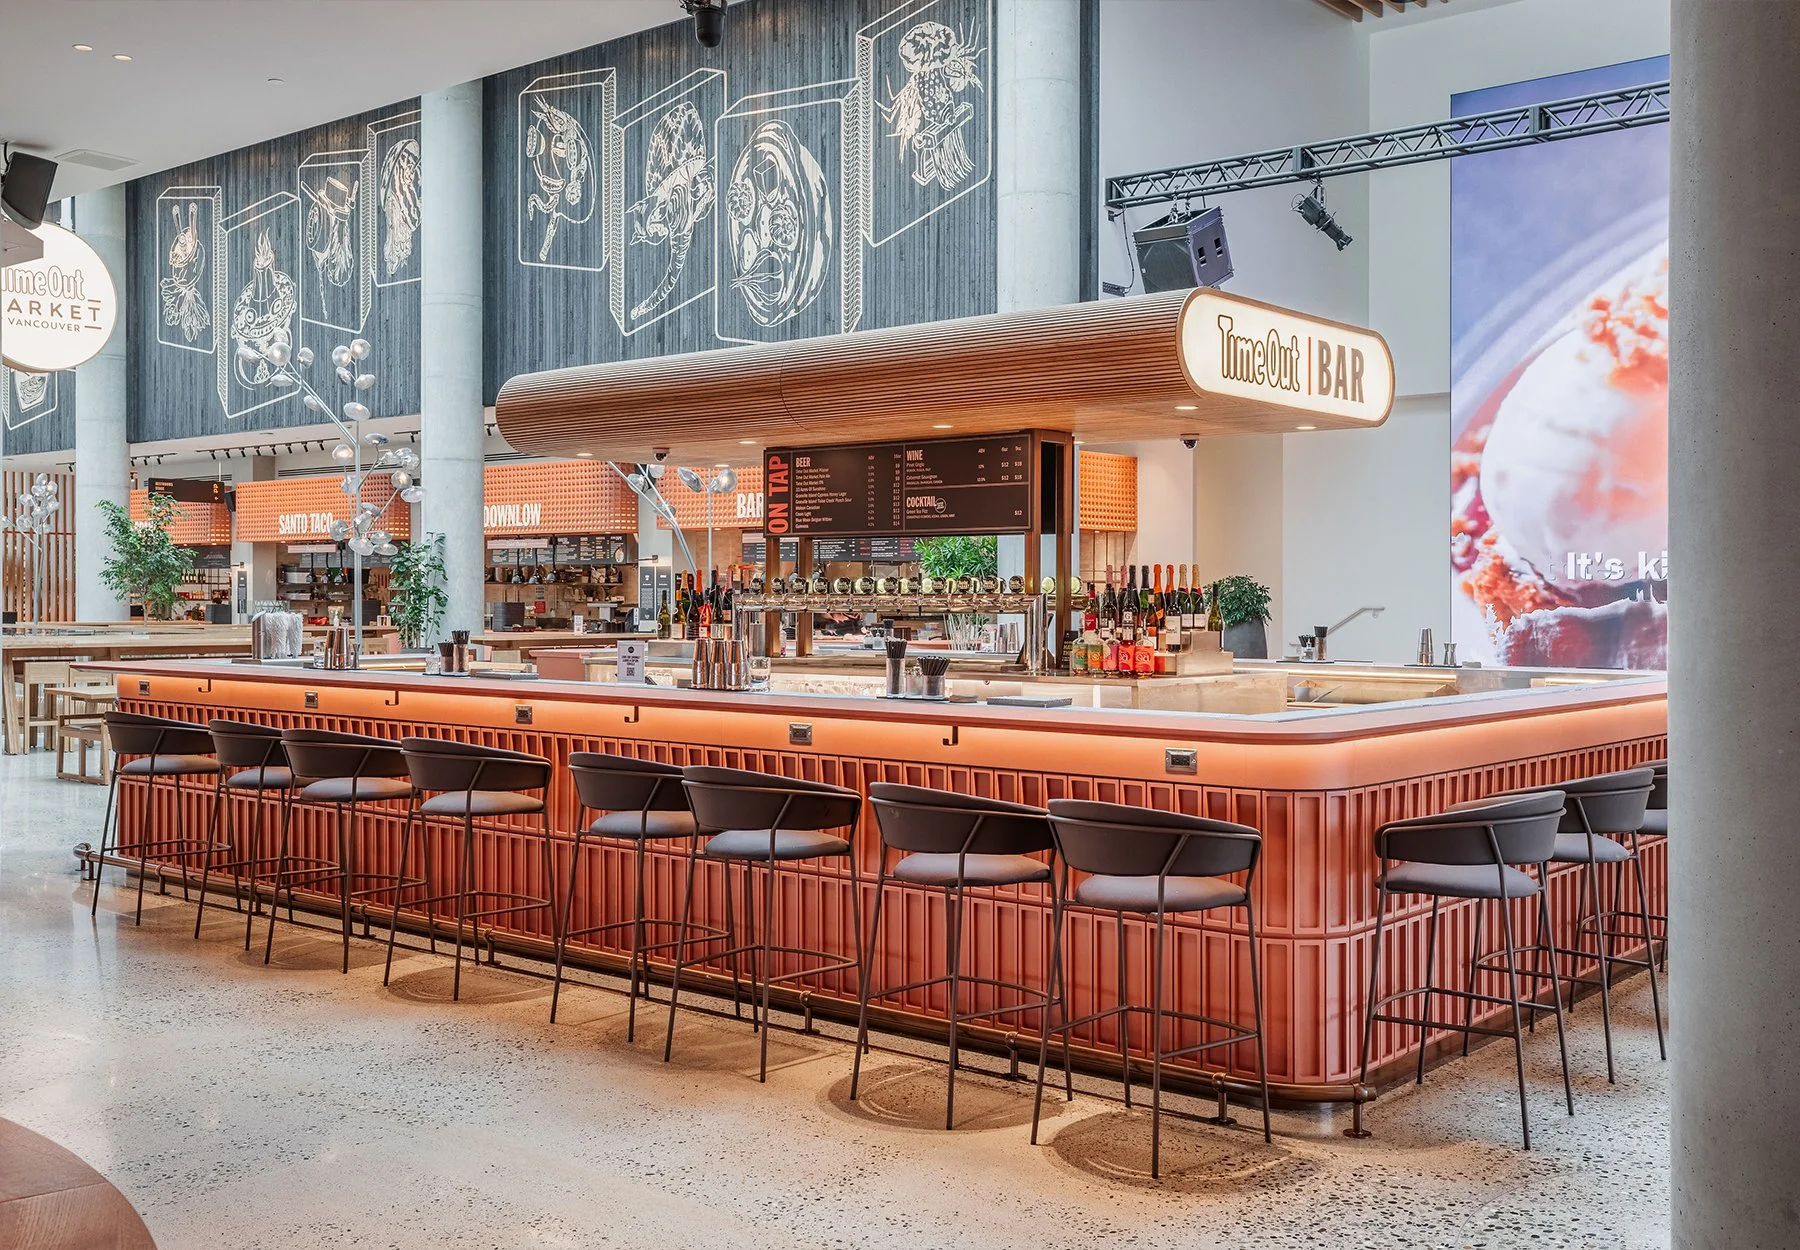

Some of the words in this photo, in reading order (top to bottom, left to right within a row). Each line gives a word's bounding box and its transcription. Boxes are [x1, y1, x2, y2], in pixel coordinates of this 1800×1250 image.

[47, 265, 85, 300] Out
[7, 298, 101, 322] ARKET
[8, 318, 80, 332] VANCOUVER
[1218, 314, 1265, 385] Time
[1266, 328, 1300, 392] Out
[1318, 339, 1364, 403] BAR
[796, 457, 810, 467] BEER
[907, 450, 923, 461] WINE
[768, 456, 788, 496] TAP
[907, 496, 936, 508] COCKTAIL
[279, 514, 308, 534] SANTO
[309, 512, 333, 533] TACO
[484, 503, 542, 528] DOWNLOW
[768, 504, 788, 533] ON
[1567, 552, 1625, 580] It's
